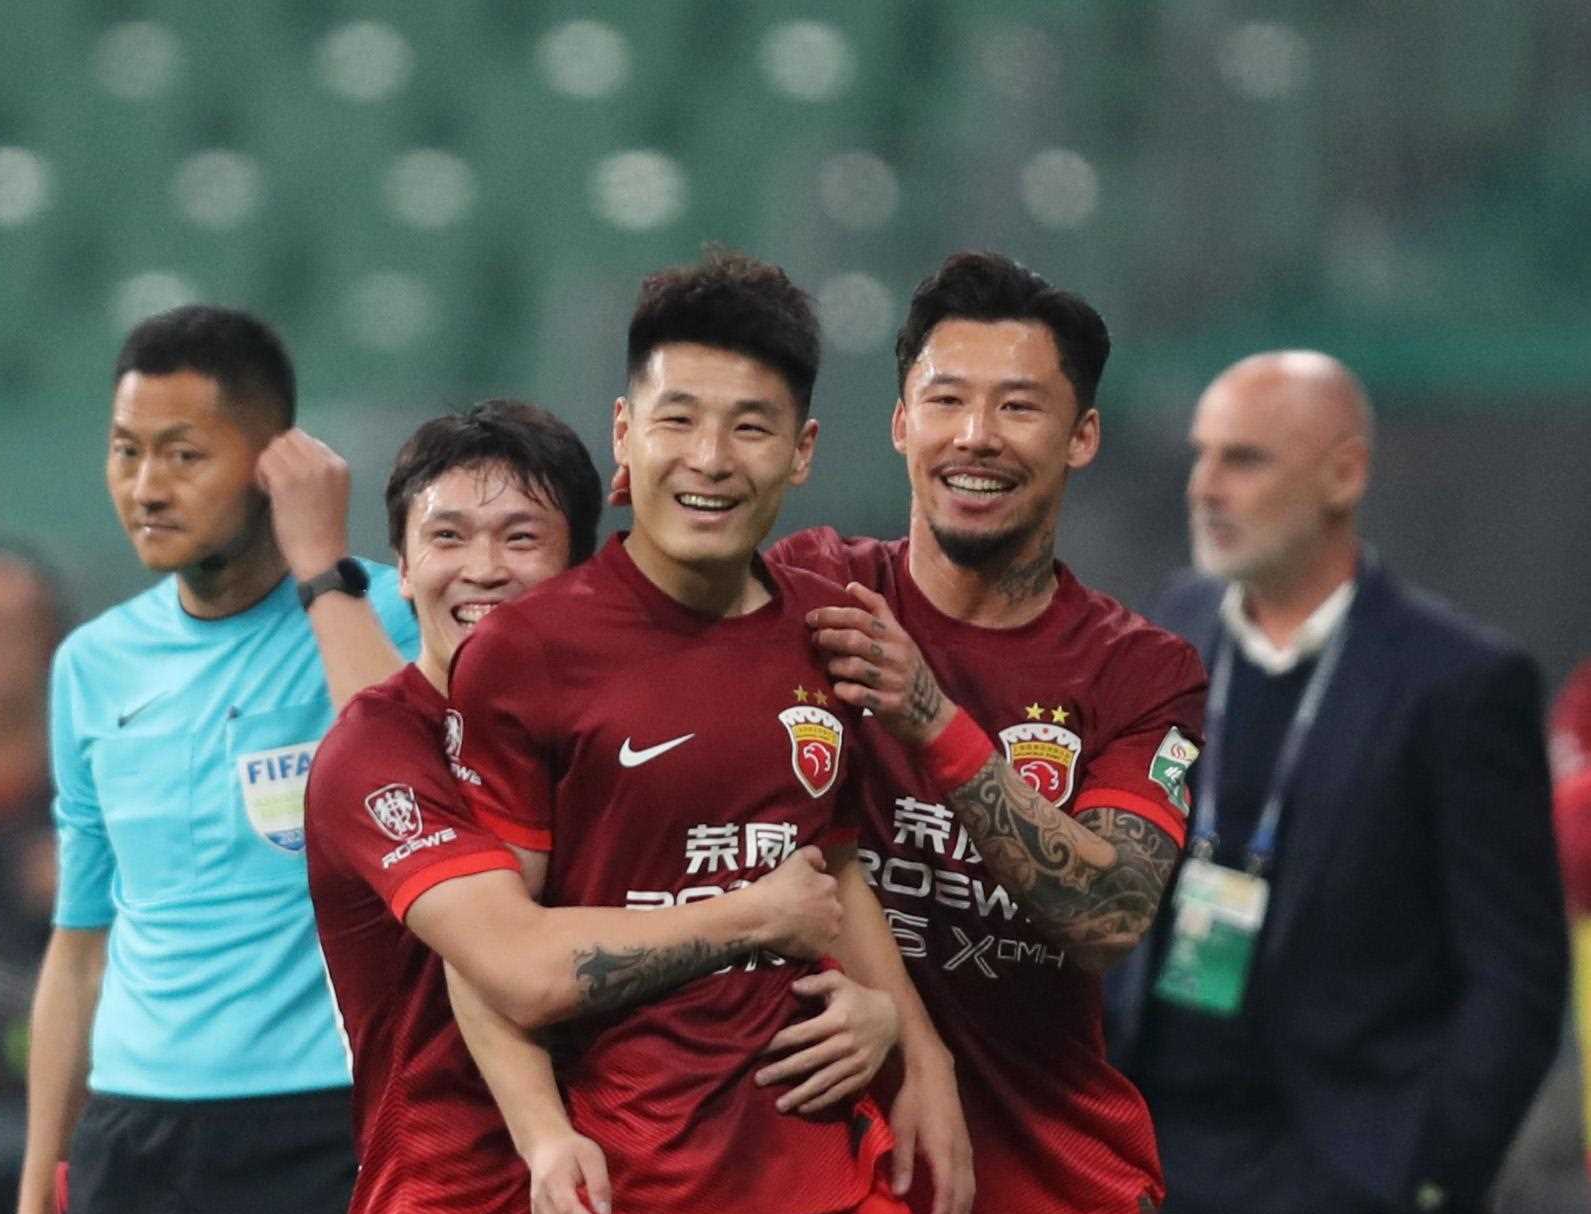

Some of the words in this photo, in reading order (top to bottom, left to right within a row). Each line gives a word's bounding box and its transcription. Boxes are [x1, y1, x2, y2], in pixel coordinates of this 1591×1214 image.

[246, 751, 310, 784] FIFA
[381, 828, 457, 869] ROEWE
[685, 822, 798, 875] 荣威
[893, 796, 983, 864] 荣
[856, 848, 1031, 923] ROEW
